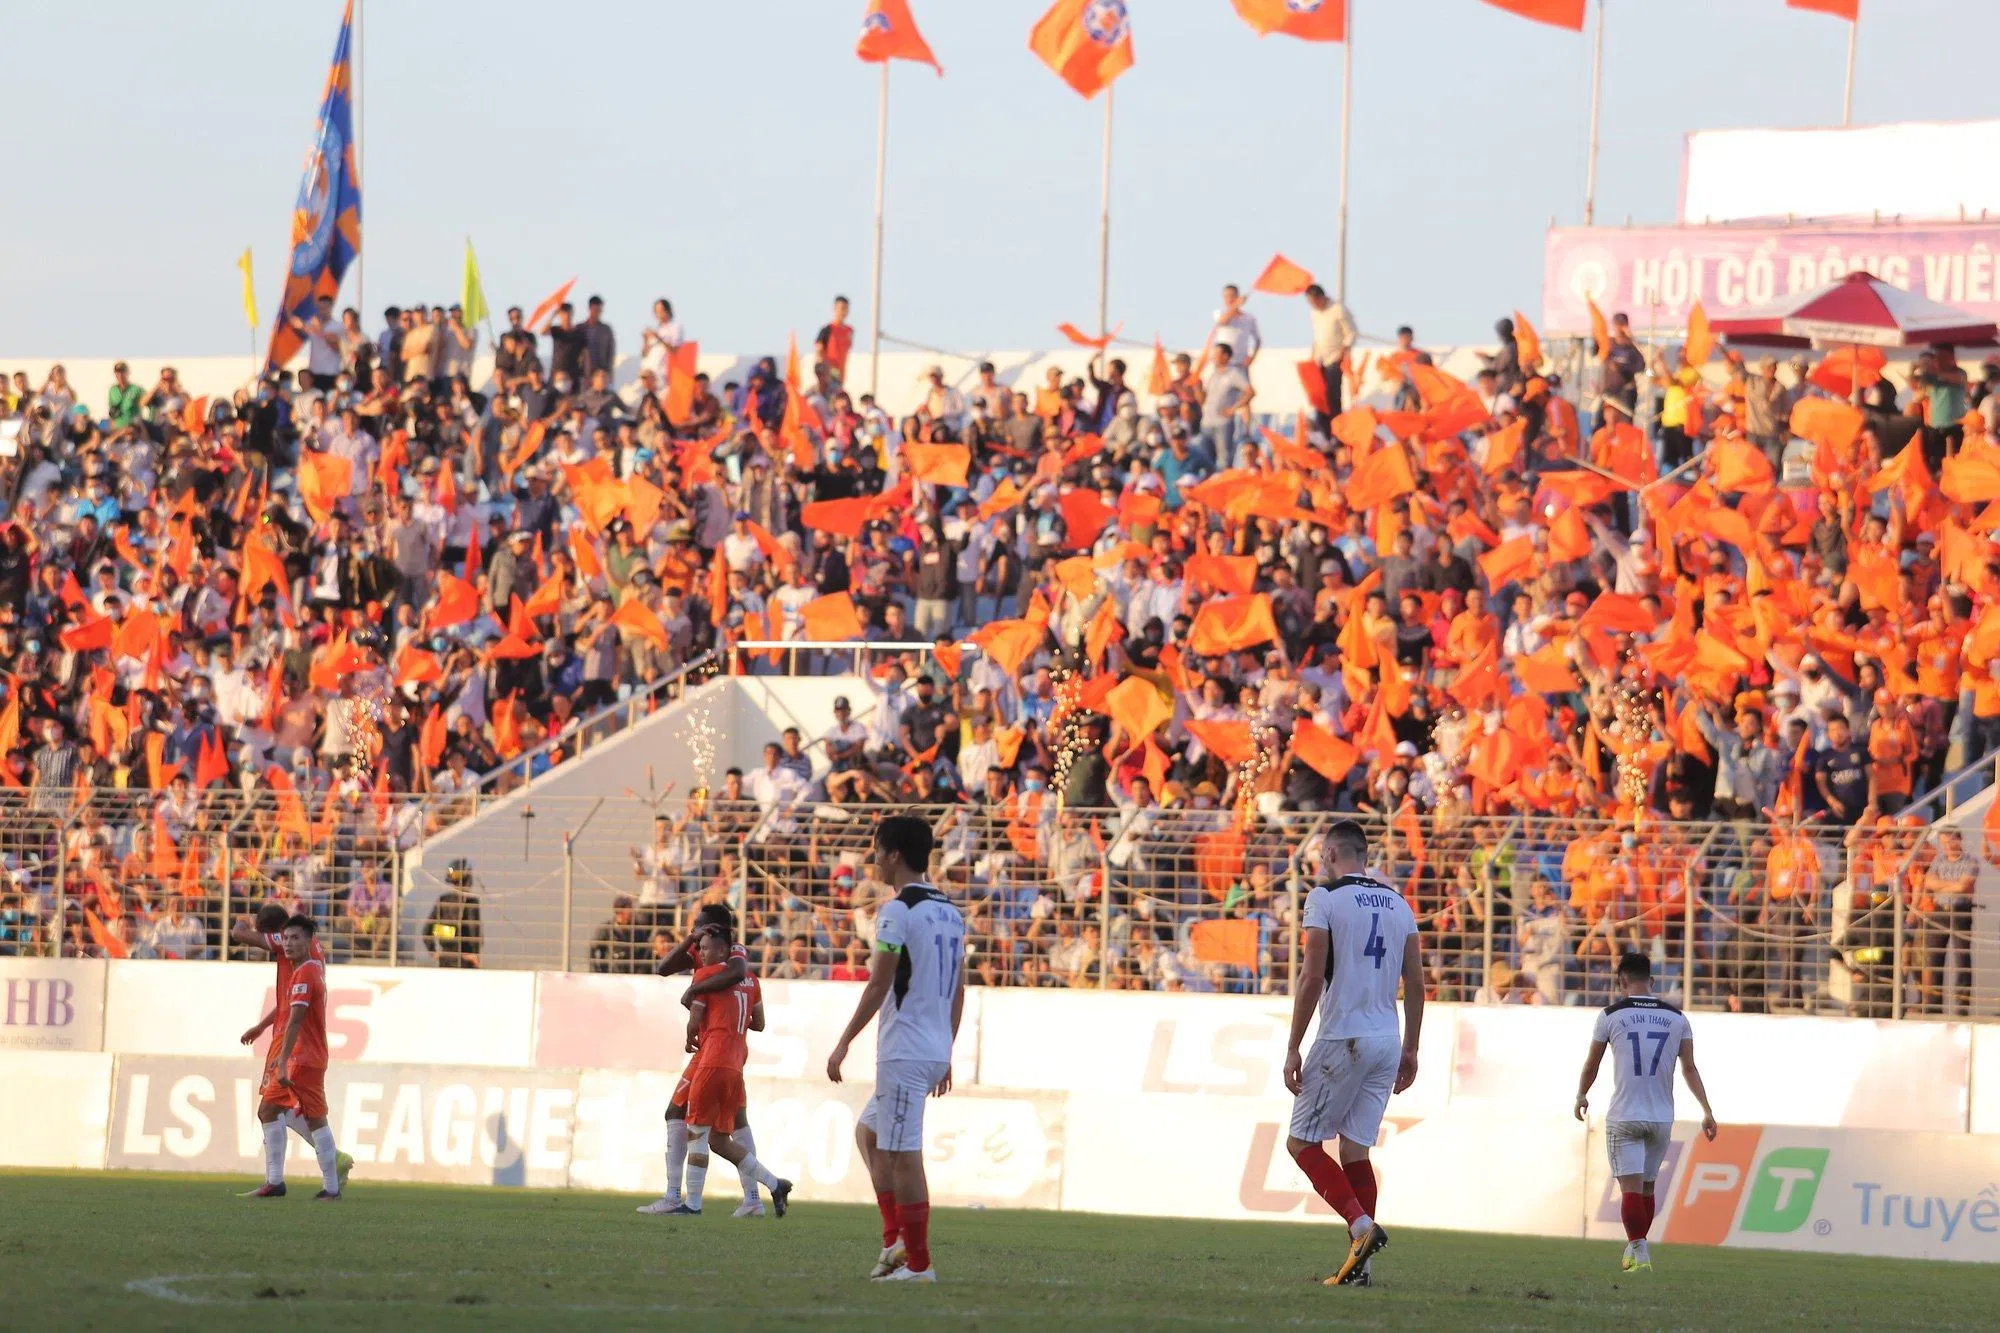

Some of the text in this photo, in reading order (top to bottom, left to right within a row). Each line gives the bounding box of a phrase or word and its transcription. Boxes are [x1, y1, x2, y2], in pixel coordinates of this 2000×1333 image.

[1364, 912, 1387, 969] 4
[734, 990, 748, 1034] 11
[1627, 1031, 1670, 1077] 17
[123, 1074, 216, 1158] LS
[234, 1078, 573, 1169] V.EAGUE
